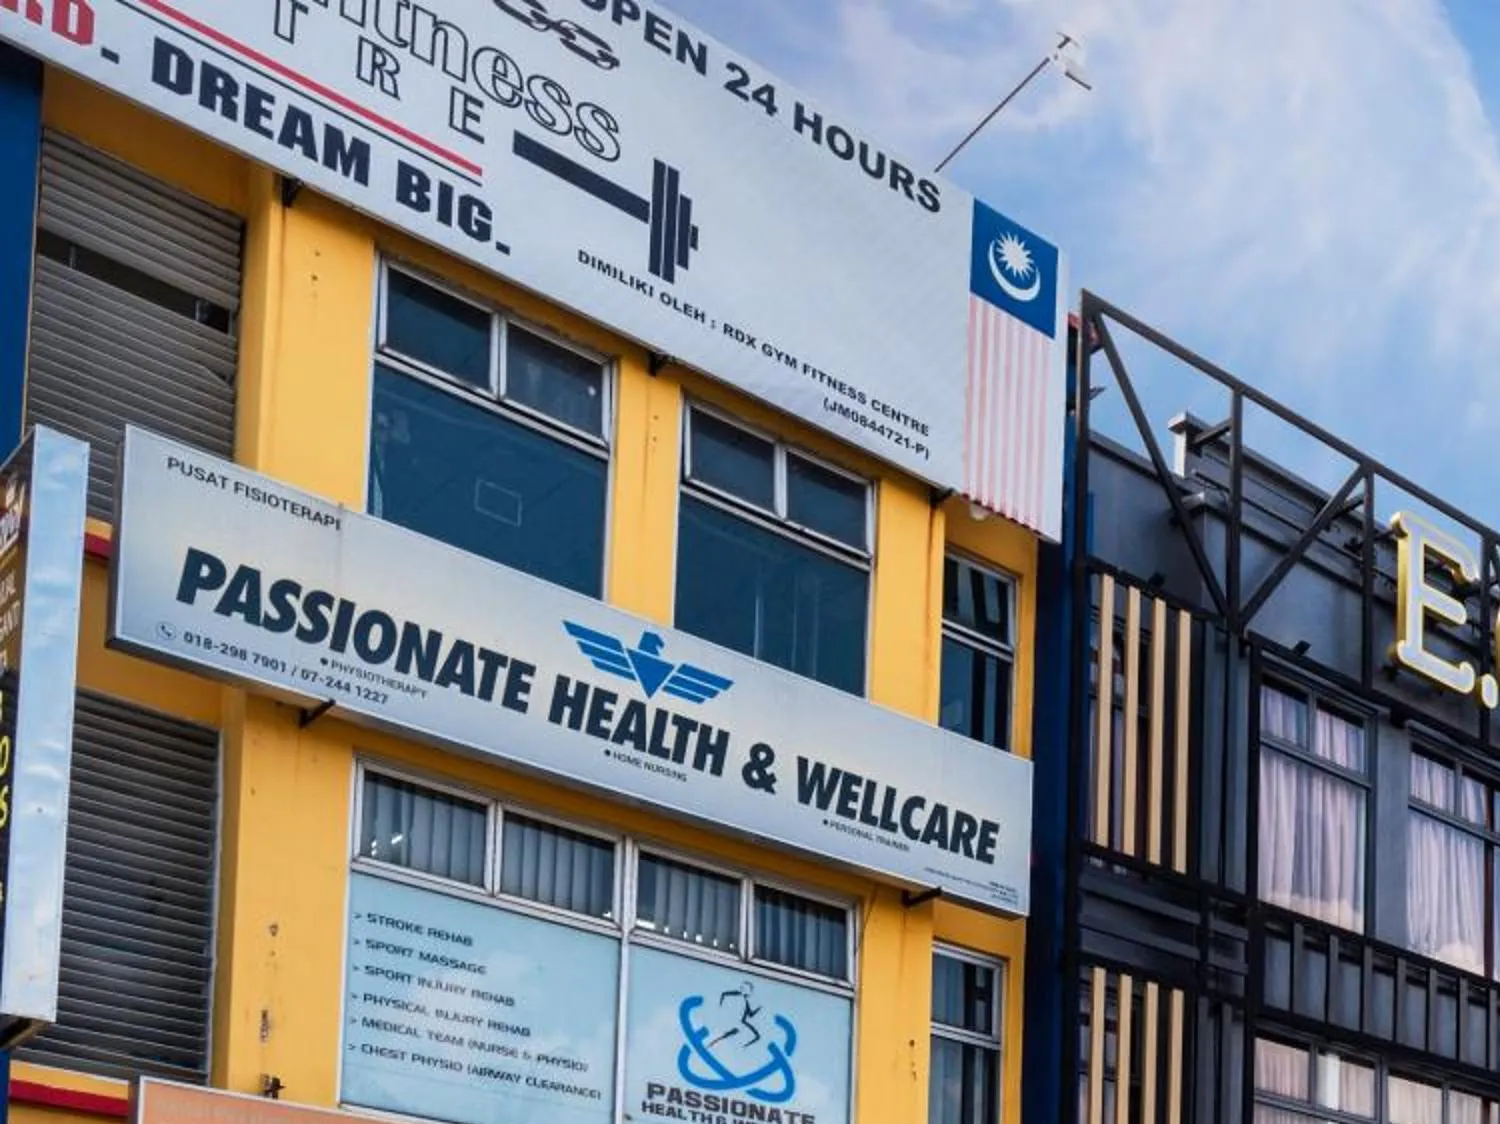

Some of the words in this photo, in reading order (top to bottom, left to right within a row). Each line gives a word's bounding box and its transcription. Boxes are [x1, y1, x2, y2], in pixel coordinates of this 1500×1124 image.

[152, 37, 370, 188] DREAM
[396, 159, 511, 255] BIG.
[725, 63, 778, 118] 24
[793, 102, 942, 213] HOURS
[577, 249, 655, 298] DIMILIKI
[659, 291, 707, 325] OLEH
[723, 322, 757, 351] RDX
[761, 343, 798, 370] GYM
[803, 363, 867, 406] FITNESS
[870, 400, 930, 437] CENTRE
[167, 456, 229, 490] PUSAT
[233, 480, 341, 532] FISIOTERAPI
[183, 631, 248, 662] 018-298
[252, 651, 287, 673] 7901
[300, 668, 351, 692] 07-244
[355, 685, 390, 705] 1227
[330, 658, 429, 700] PHYSIOTHERAPY
[175, 546, 537, 714] PASSIONATE
[548, 675, 731, 777] HEALTH
[742, 742, 777, 795] &
[797, 754, 1000, 866] WELLCARE
[613, 750, 643, 769] HOME
[643, 761, 688, 783] NURSING
[366, 912, 424, 936] STROKE
[427, 926, 474, 947] REHAB
[365, 938, 414, 958] SPORT
[418, 951, 488, 975] MASSAGE
[363, 964, 413, 985] SPORT
[417, 976, 468, 996] INJURY
[471, 989, 516, 1008] REHAB
[361, 1016, 420, 1038] MEDICAL
[427, 1030, 466, 1049] TEAM
[467, 1039, 519, 1060] (NURSE
[362, 992, 431, 1017] PHYSICAL
[435, 1008, 484, 1028] INJURY
[487, 1019, 532, 1038] REHAB
[360, 1042, 407, 1062] CHEST
[411, 1052, 463, 1073] PHYSIO
[467, 1065, 522, 1085] (AIRWAY
[525, 1076, 602, 1101] CLEARANCE)
